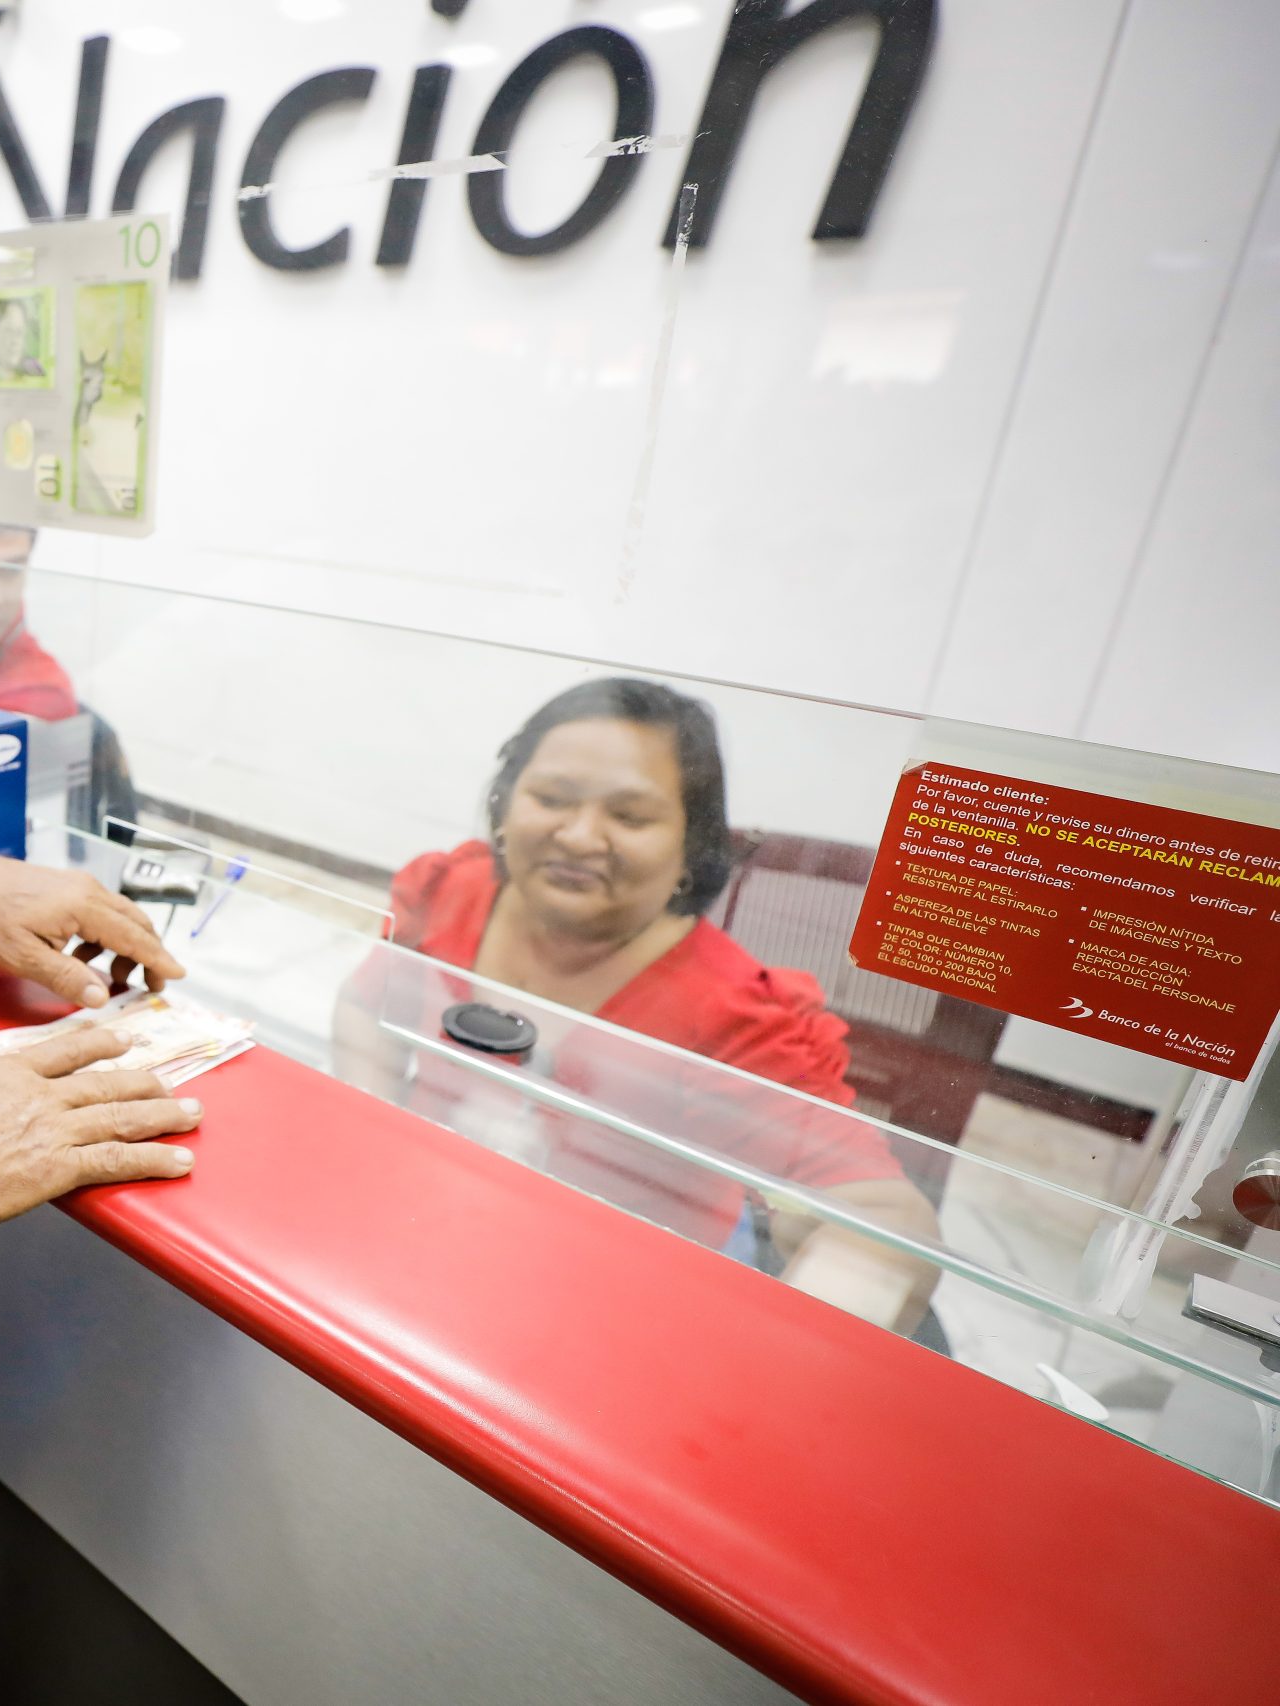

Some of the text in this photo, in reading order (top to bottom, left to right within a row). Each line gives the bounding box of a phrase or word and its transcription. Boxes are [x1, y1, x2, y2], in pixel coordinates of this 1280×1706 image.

[119, 221, 161, 268] 10
[921, 771, 1049, 805] Estimado cliente:
[908, 812, 1020, 846] POSTERIORES.
[912, 800, 1280, 887] de la ventanilla. NO SE ACEPTARÁN RECLAM
[917, 785, 1280, 870] Por favor, cuente y revise su dinero antes de retir
[899, 841, 1075, 890] siguientes características:
[904, 827, 921, 838] En
[932, 835, 964, 848] caso
[975, 844, 992, 855] de
[1005, 851, 1043, 868] duda,
[1056, 863, 1175, 898] recomendamos
[1190, 894, 1257, 915] verificar
[907, 863, 1018, 897] TEXTURA DE PAPEL:
[895, 894, 1040, 937] ASPEREZA DE LAS TINTAS
[902, 873, 1058, 918] RESISTENTE AL ESTIRARLO
[893, 903, 988, 935] EN ALTO RELIEVE
[1093, 909, 1215, 946] IMPRESIÓN NÍTIDA
[880, 942, 894, 952] 20,
[898, 947, 911, 958] 50,
[917, 953, 934, 964] 100
[945, 961, 964, 971] 200
[966, 968, 996, 980] BAJO
[884, 933, 1013, 976] DE COLOR: NÚMERO 10,
[887, 923, 1005, 961] TINTAS QUE CAMBIAN
[1081, 942, 1192, 977] MARCA DE AGUA:
[1089, 920, 1107, 931] DE
[1110, 925, 1180, 949] IMÁGENES
[1196, 946, 1242, 965] TEXTO
[878, 952, 997, 993] EL ESCUDO NACIONAL
[1072, 963, 1236, 1013] EXACTA DEL PERSONAJE
[1076, 952, 1183, 987] REPRODUCCIÓN
[1098, 1010, 1236, 1057] Banco de la Nación
[1174, 1044, 1196, 1054] banco
[1198, 1050, 1207, 1058] de
[1210, 1054, 1231, 1065] todos
